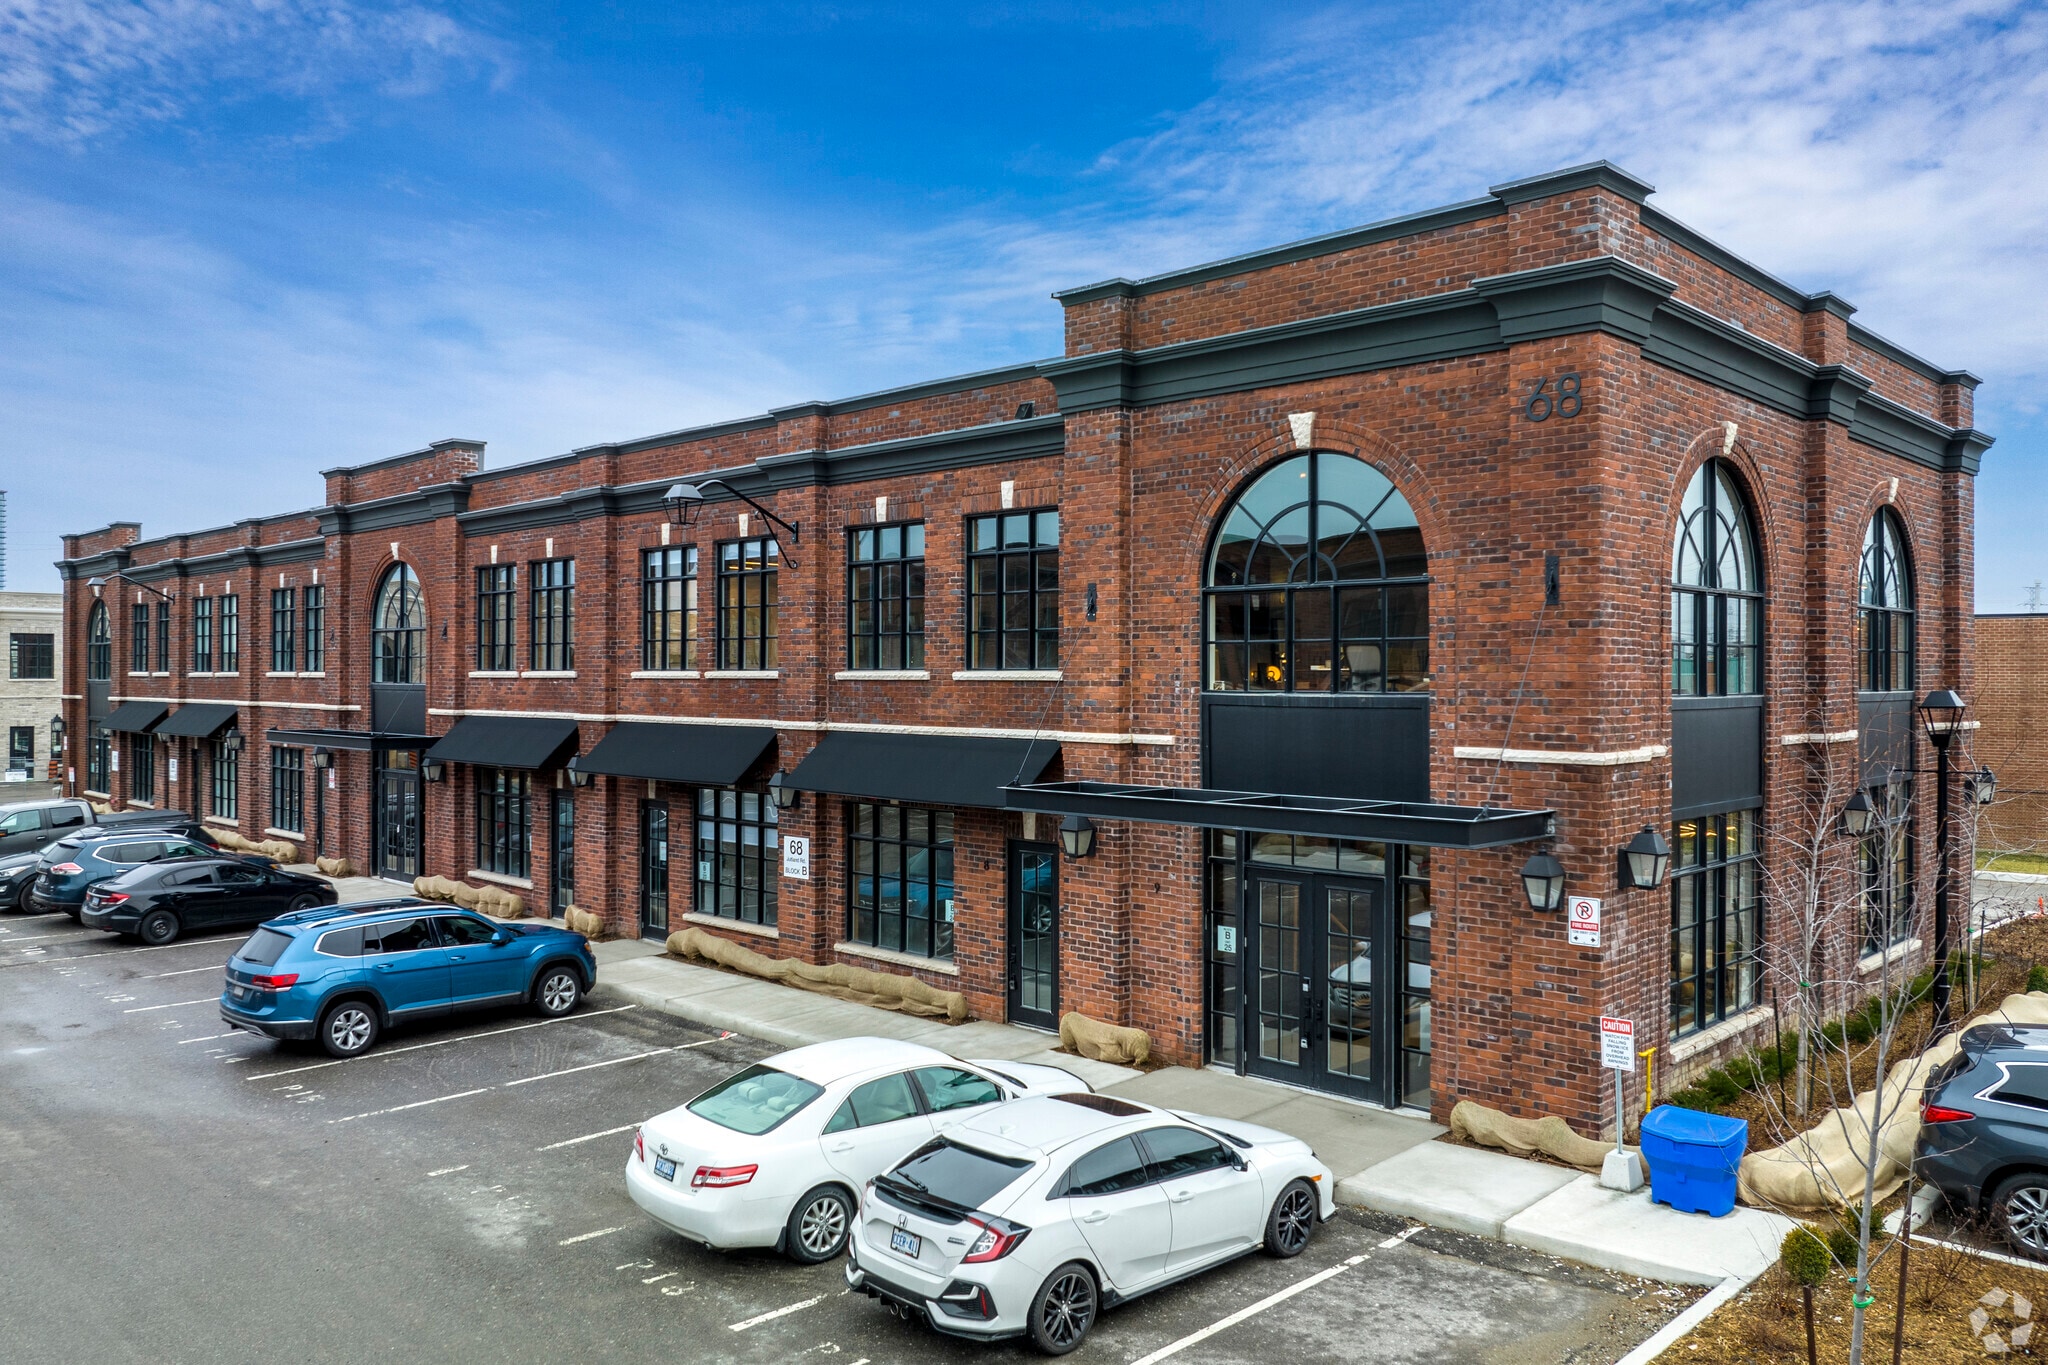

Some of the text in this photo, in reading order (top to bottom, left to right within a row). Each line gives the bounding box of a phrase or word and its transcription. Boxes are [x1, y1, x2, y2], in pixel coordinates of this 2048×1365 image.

[1525, 373, 1582, 422] 68
[790, 840, 803, 855] 68
[802, 866, 807, 875] B
[984, 860, 989, 870] 8
[1154, 882, 1160, 893] 9
[1225, 931, 1231, 939] B
[1603, 1021, 1630, 1032] CAUTION
